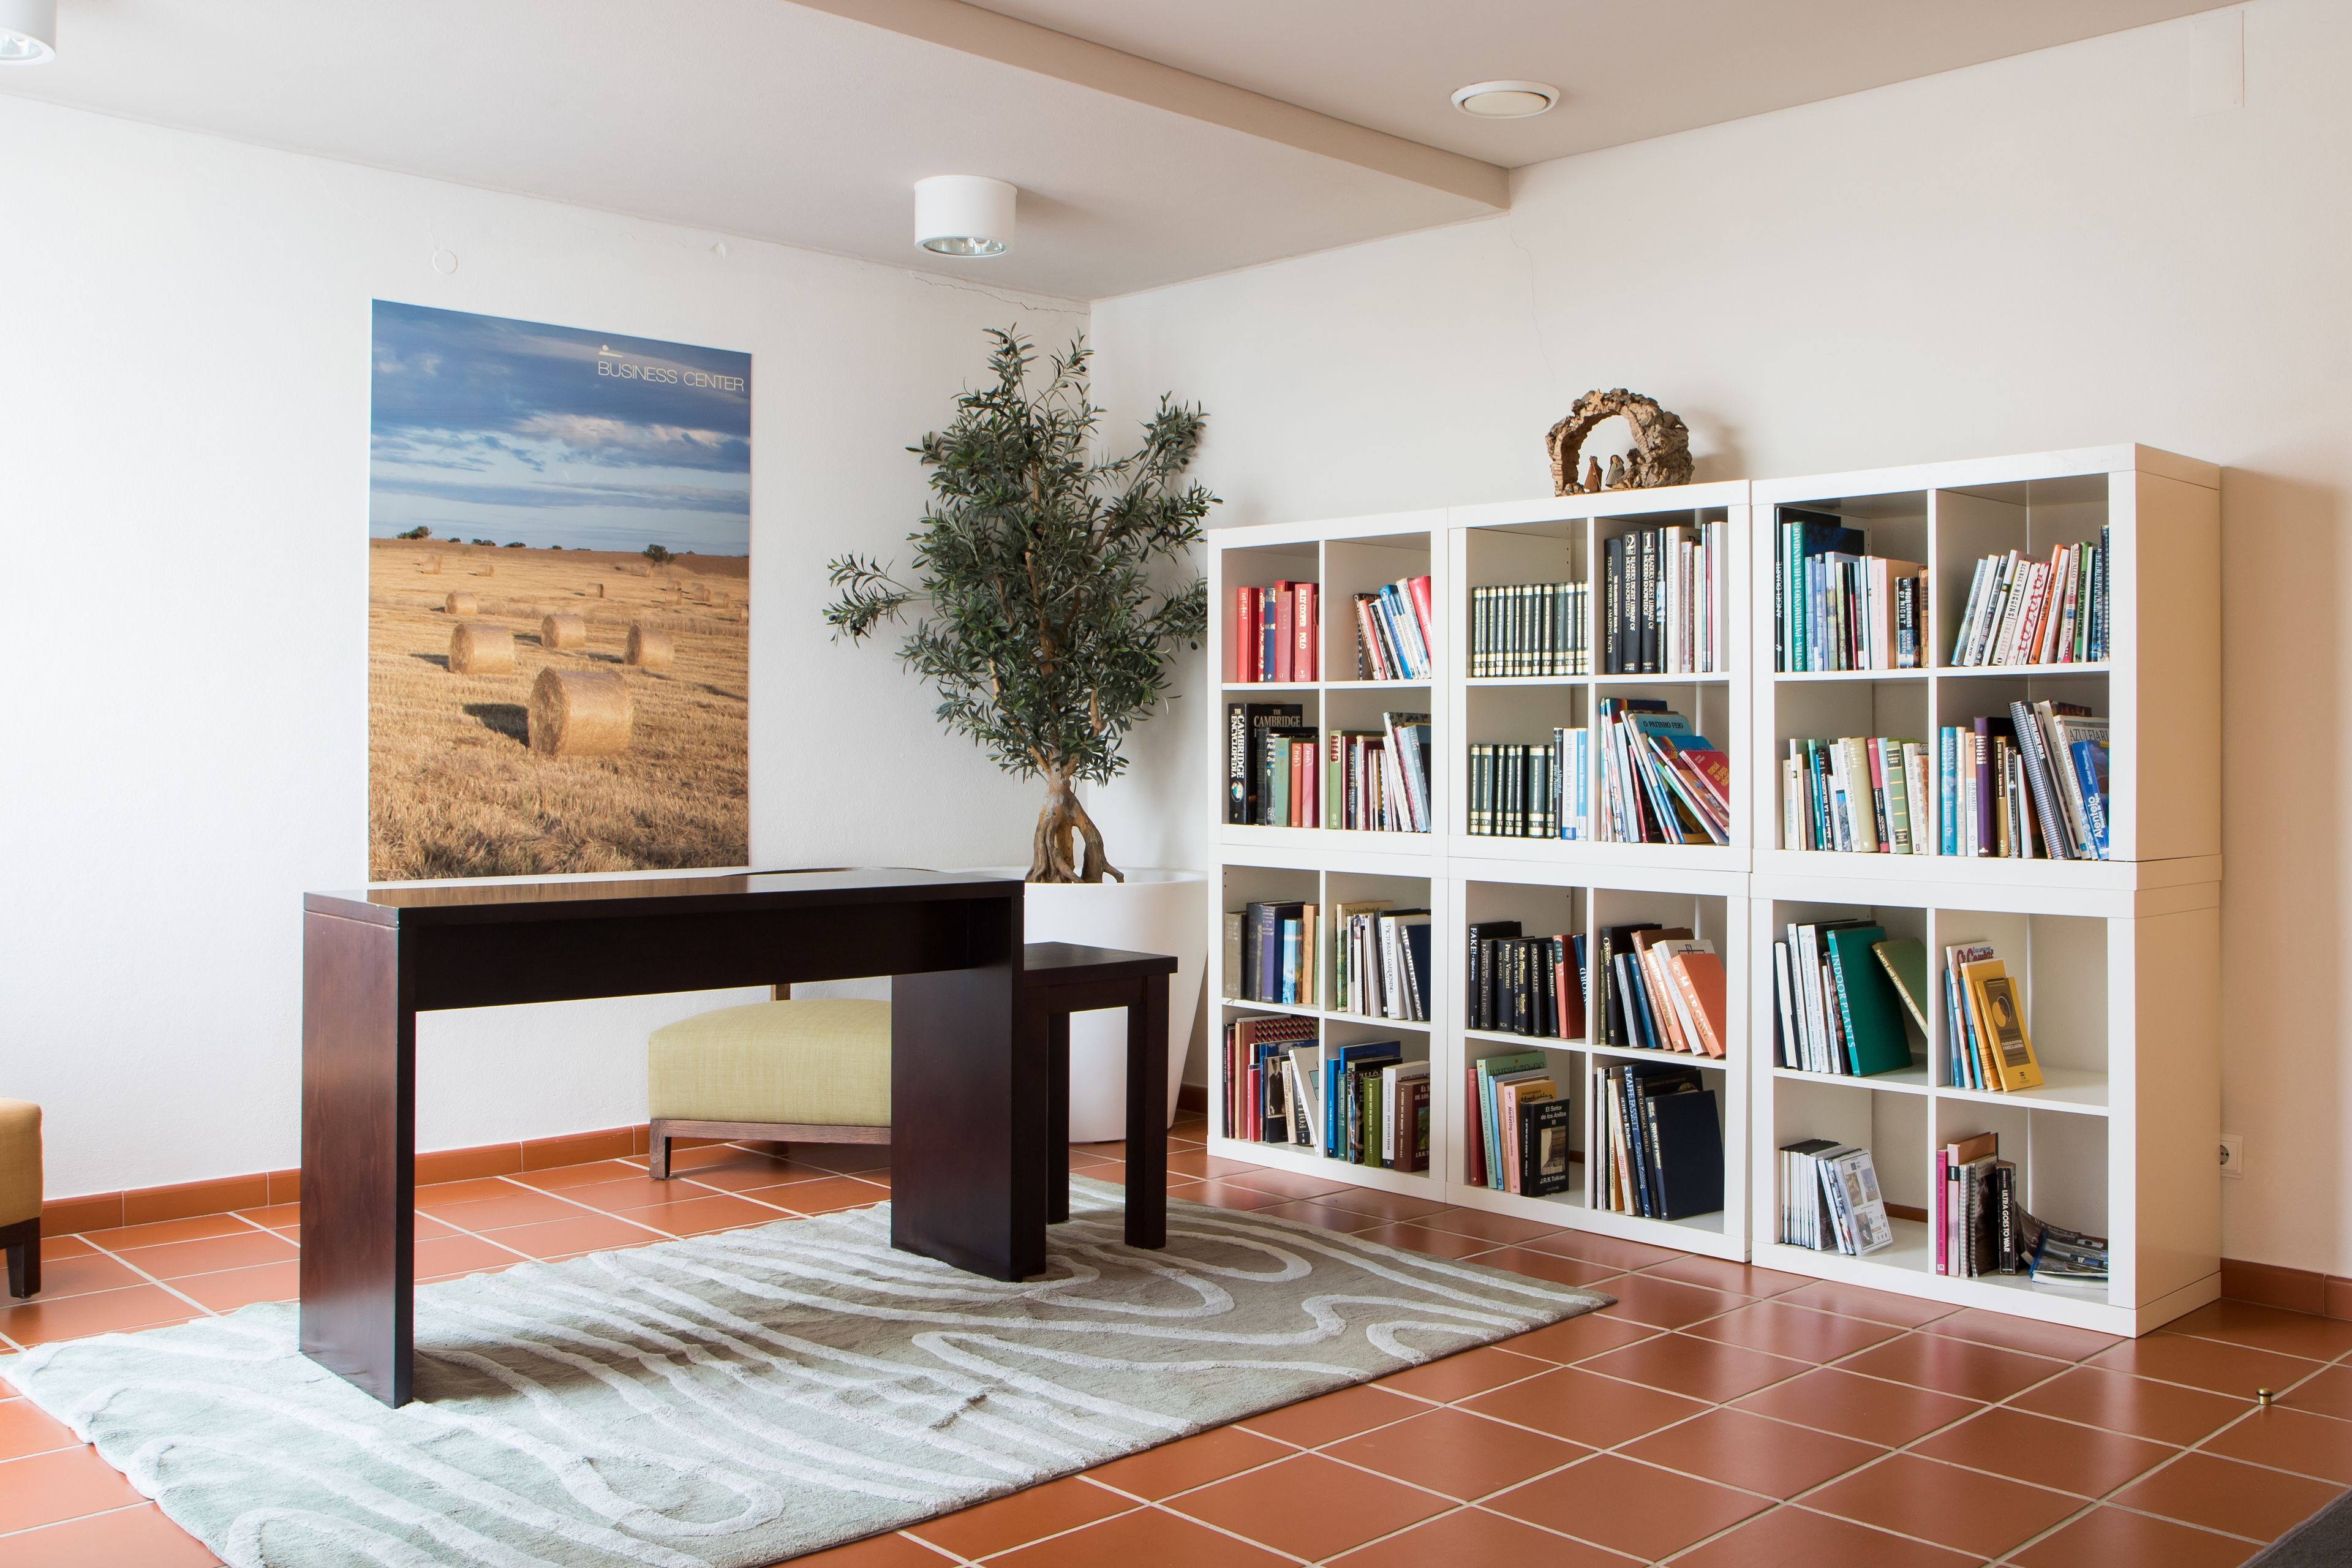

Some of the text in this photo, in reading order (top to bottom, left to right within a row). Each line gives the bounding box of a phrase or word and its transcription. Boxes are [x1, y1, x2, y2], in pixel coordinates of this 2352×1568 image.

[598, 360, 744, 391] BUSINESS CENTER
[1627, 535, 1635, 549] 2
[1793, 525, 1801, 577] HUMANIDADE
[1794, 578, 1801, 589] DA
[2008, 564, 2026, 617] GEORGE HIGGINS
[2079, 592, 2085, 600] UP
[1794, 589, 1803, 638] PATRIMÓNIO
[2040, 597, 2049, 621] HEALTH
[1648, 622, 1654, 630] OF
[1254, 716, 1300, 727] CAMBRIDGE
[2029, 714, 2046, 760] PORTALEGRE POLIS
[2069, 767, 2082, 802] AZULEJARIA
[2087, 796, 2103, 838] Alentejo
[1405, 949, 1417, 990] OMELETTE
[1499, 952, 1502, 960] NO
[1875, 949, 1888, 967] PLANTS
[1893, 977, 1908, 998] FLOWERS
[1831, 954, 1846, 999] INDOOR
[1841, 1003, 1855, 1047] PLANTS
[1482, 1093, 1486, 1101] TO
[1482, 1102, 1487, 1112] GO
[1629, 1099, 1638, 1132] FASSETT
